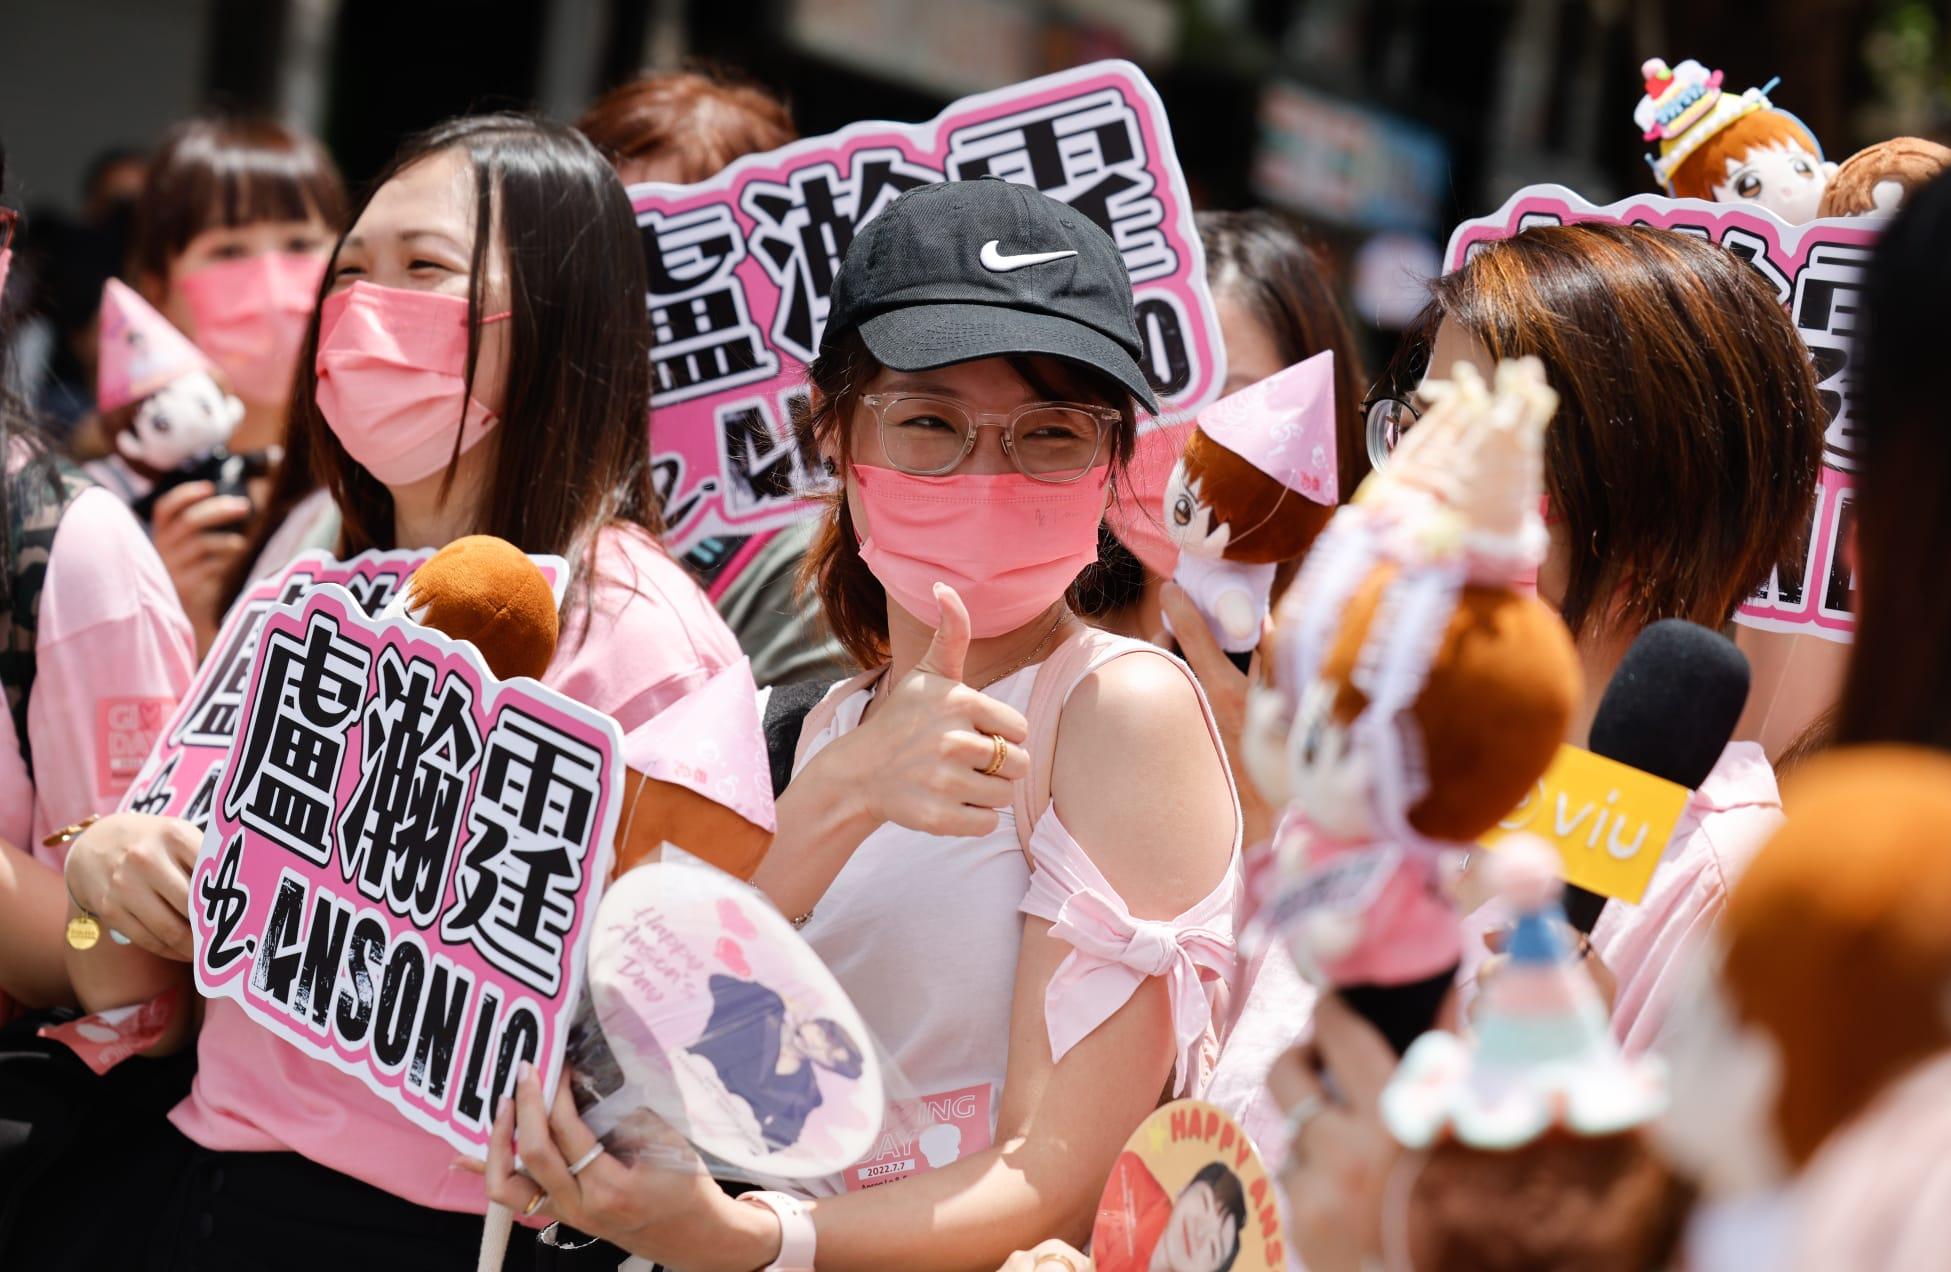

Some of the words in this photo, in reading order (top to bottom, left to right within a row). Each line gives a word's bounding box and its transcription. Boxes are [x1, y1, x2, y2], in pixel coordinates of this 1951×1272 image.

[227, 615, 602, 990] 盧瀚霆
[251, 876, 470, 1101] ANSON
[616, 955, 665, 1003] Day
[632, 904, 705, 972] Happy
[867, 1162, 906, 1178] 2022.7.7
[1170, 1106, 1251, 1170] HAPPY
[1247, 1177, 1283, 1272] ANS
